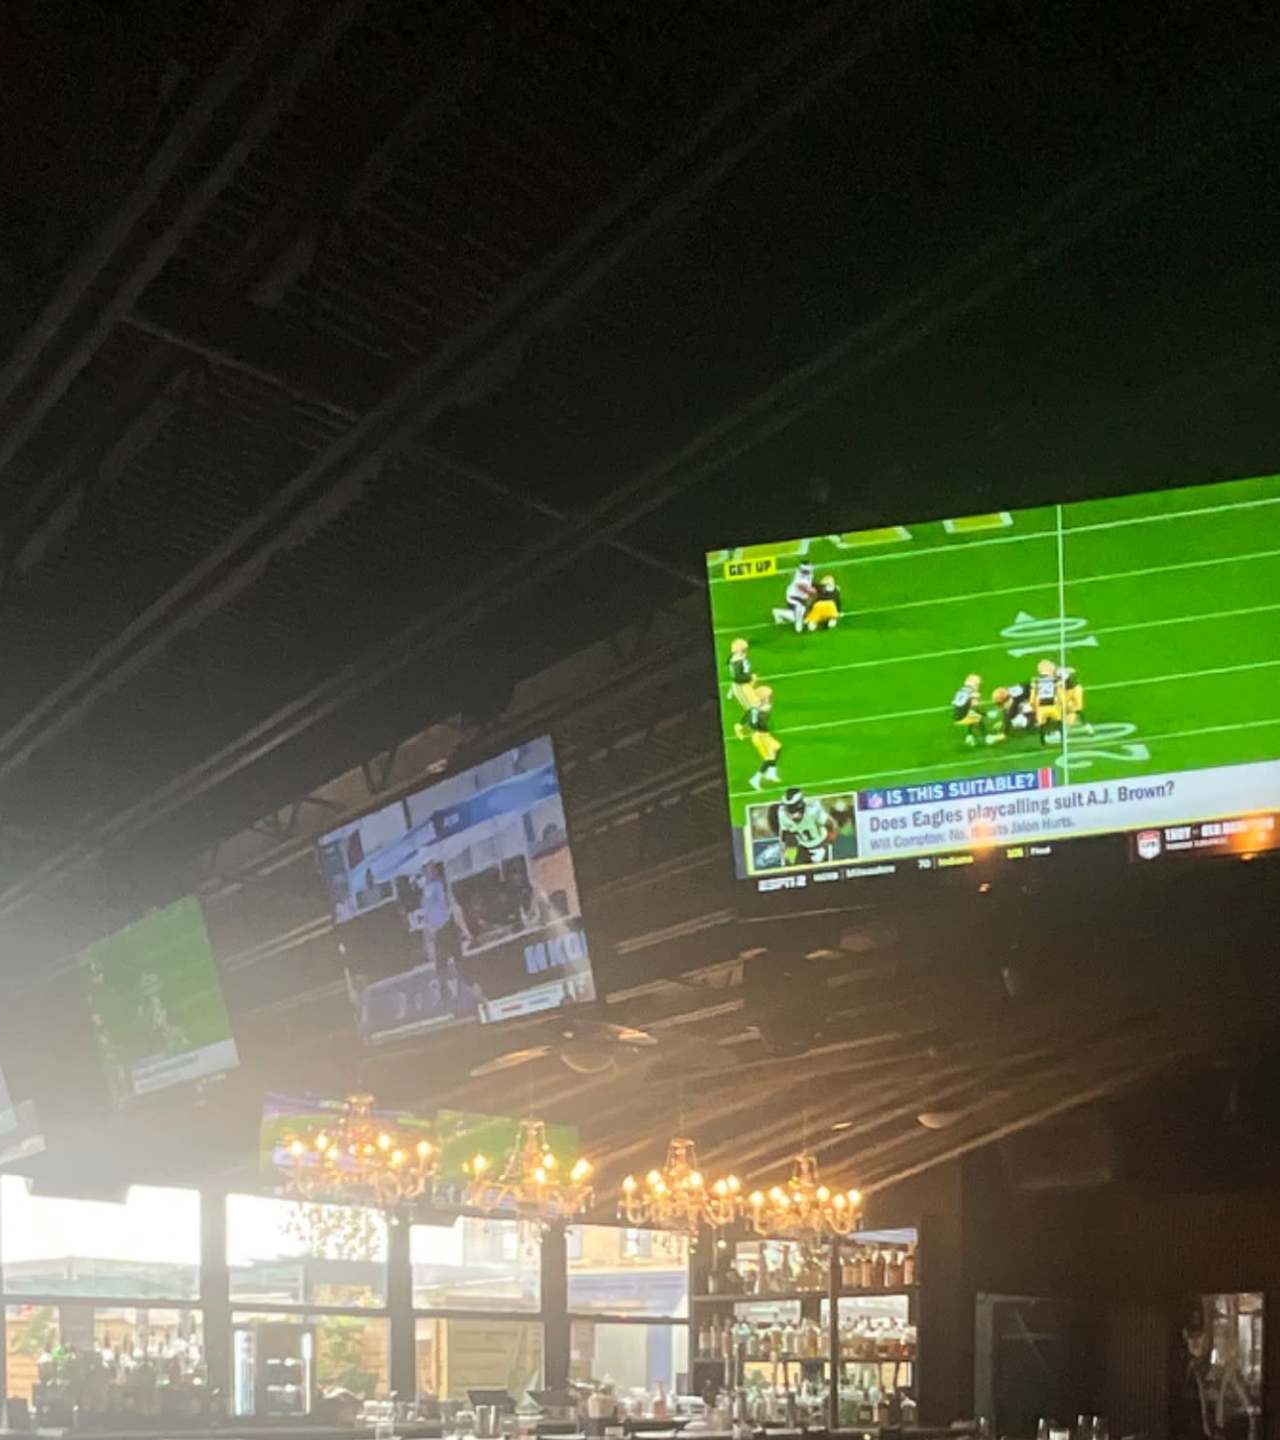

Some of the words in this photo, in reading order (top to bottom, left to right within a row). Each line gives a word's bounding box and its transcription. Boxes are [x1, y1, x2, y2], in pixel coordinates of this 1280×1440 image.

[729, 563, 752, 576] GET
[756, 560, 772, 573] UP
[886, 790, 903, 804] IS
[908, 784, 944, 803] THIS
[948, 772, 1035, 798] SUITABLE?
[869, 811, 909, 832] Does
[912, 807, 963, 829] Eagles
[968, 797, 1050, 821] playcalling
[1054, 791, 1084, 810] suit
[1086, 787, 1113, 806] A.J.
[1118, 780, 1175, 803] Brown?
